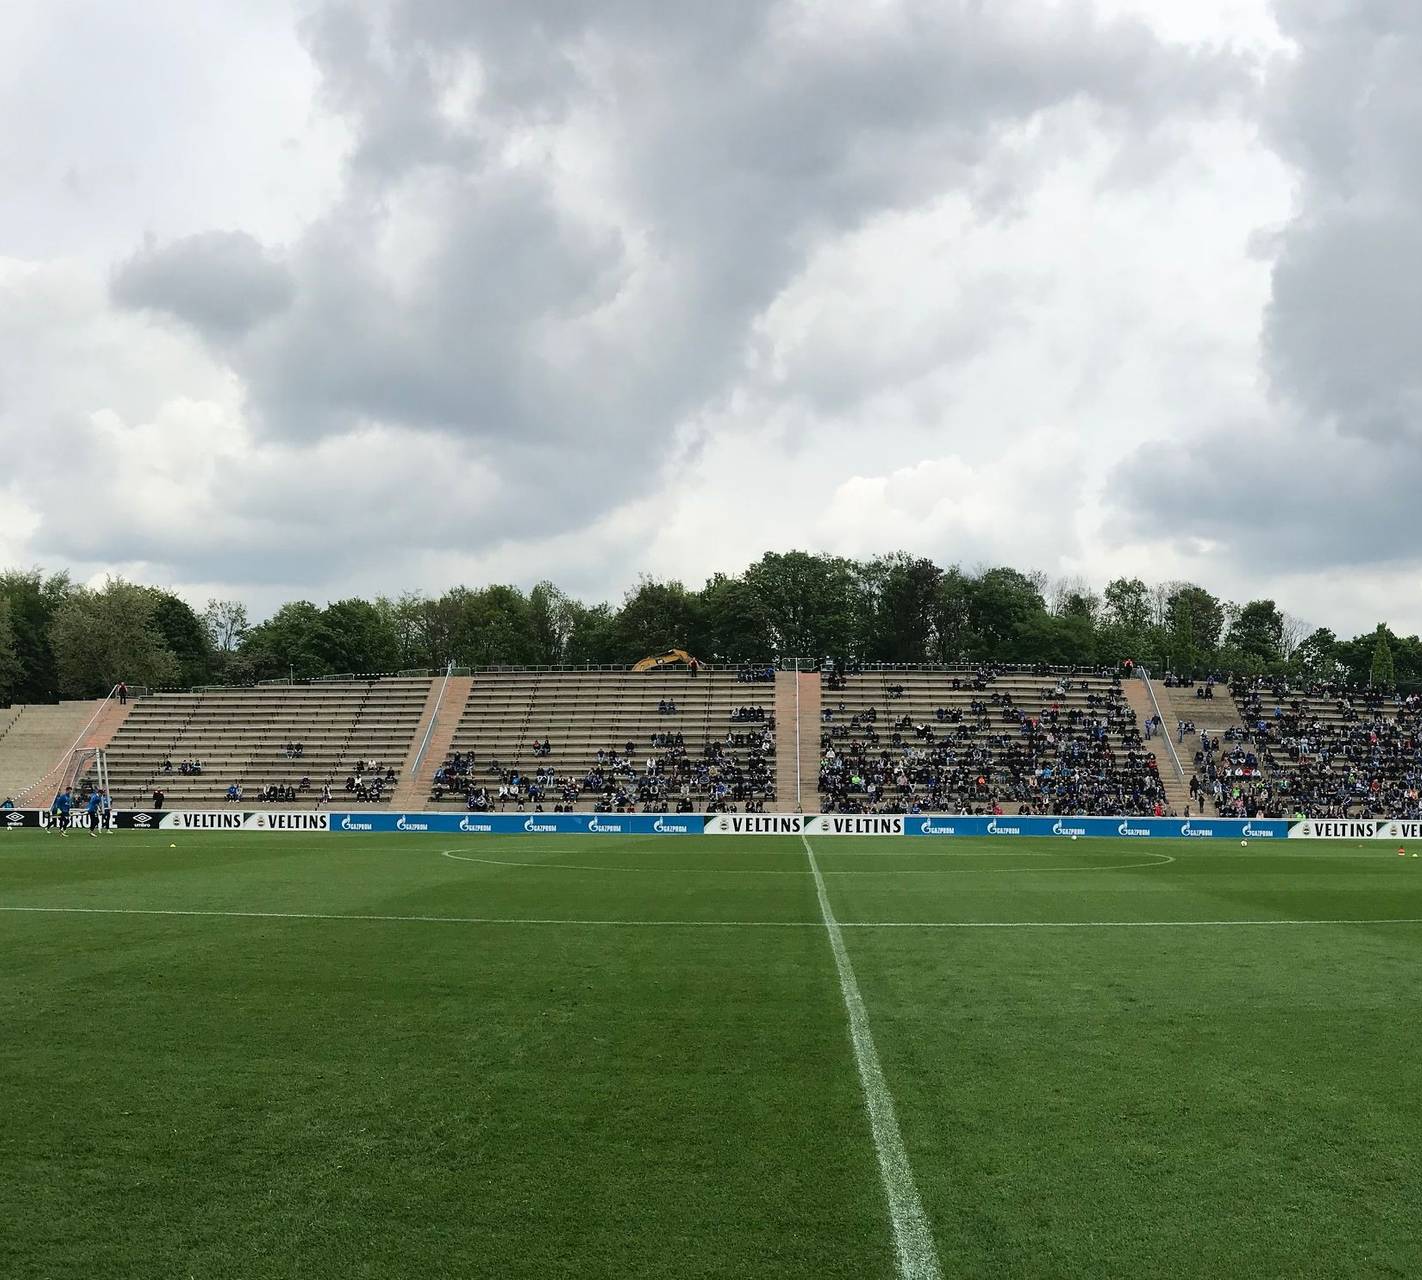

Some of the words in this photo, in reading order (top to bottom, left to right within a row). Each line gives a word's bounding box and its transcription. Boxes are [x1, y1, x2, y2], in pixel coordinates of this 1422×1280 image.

[184, 814, 241, 828] VELTINS
[268, 814, 327, 829] VELTINS
[733, 817, 801, 833] VELTINS
[405, 823, 428, 831] GAZPROM
[469, 824, 492, 832] GAZPROM
[534, 824, 557, 832] GAZPROM
[664, 825, 687, 833] GAZPROM
[834, 818, 902, 833] VELTINS
[996, 827, 1020, 835] GAZPROM
[1127, 828, 1150, 836] GAZPROM
[1190, 829, 1213, 837] GAZPROM
[1315, 823, 1373, 837] VELTINS
